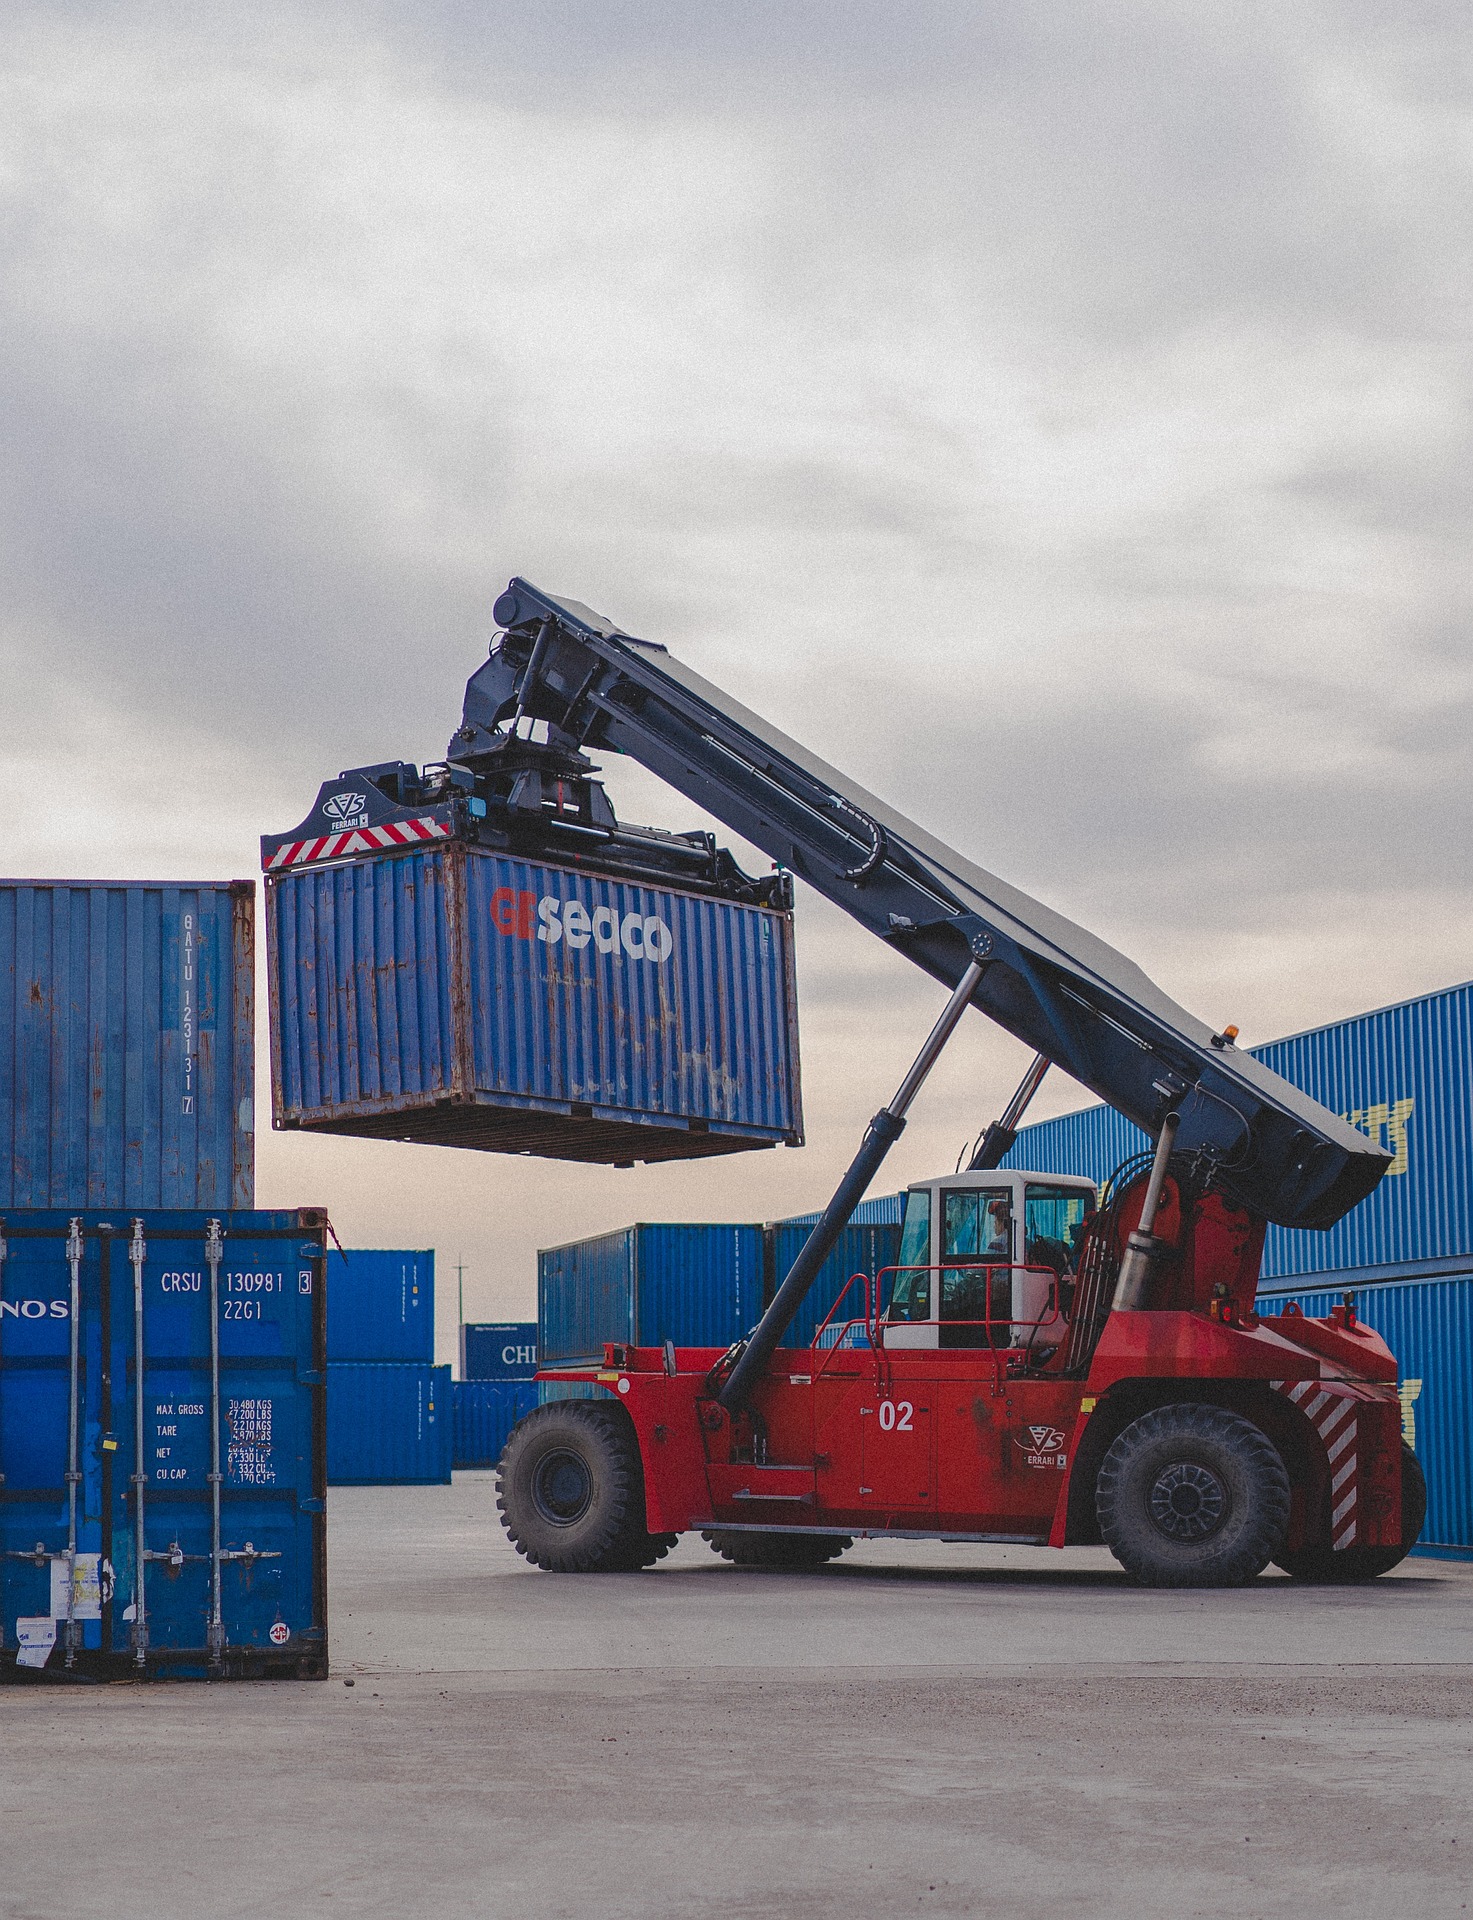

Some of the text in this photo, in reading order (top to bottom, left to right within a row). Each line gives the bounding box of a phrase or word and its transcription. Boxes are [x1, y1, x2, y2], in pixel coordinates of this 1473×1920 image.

[331, 818, 358, 831] FERRARI
[183, 915, 193, 1113] GATU 123131 7
[161, 1272, 311, 1293] CRSU 130981 3
[223, 1300, 261, 1319] 22G1
[501, 1345, 537, 1365] CHI
[156, 1404, 204, 1415] MAX. GROSS
[229, 1400, 272, 1410] 30.480 KGS
[256, 1410, 272, 1420] LBS
[878, 1401, 913, 1431] 02
[156, 1425, 177, 1436] TARE
[256, 1420, 272, 1431] KGS
[156, 1447, 171, 1459] NET
[1024, 1455, 1055, 1465] ERRARI
